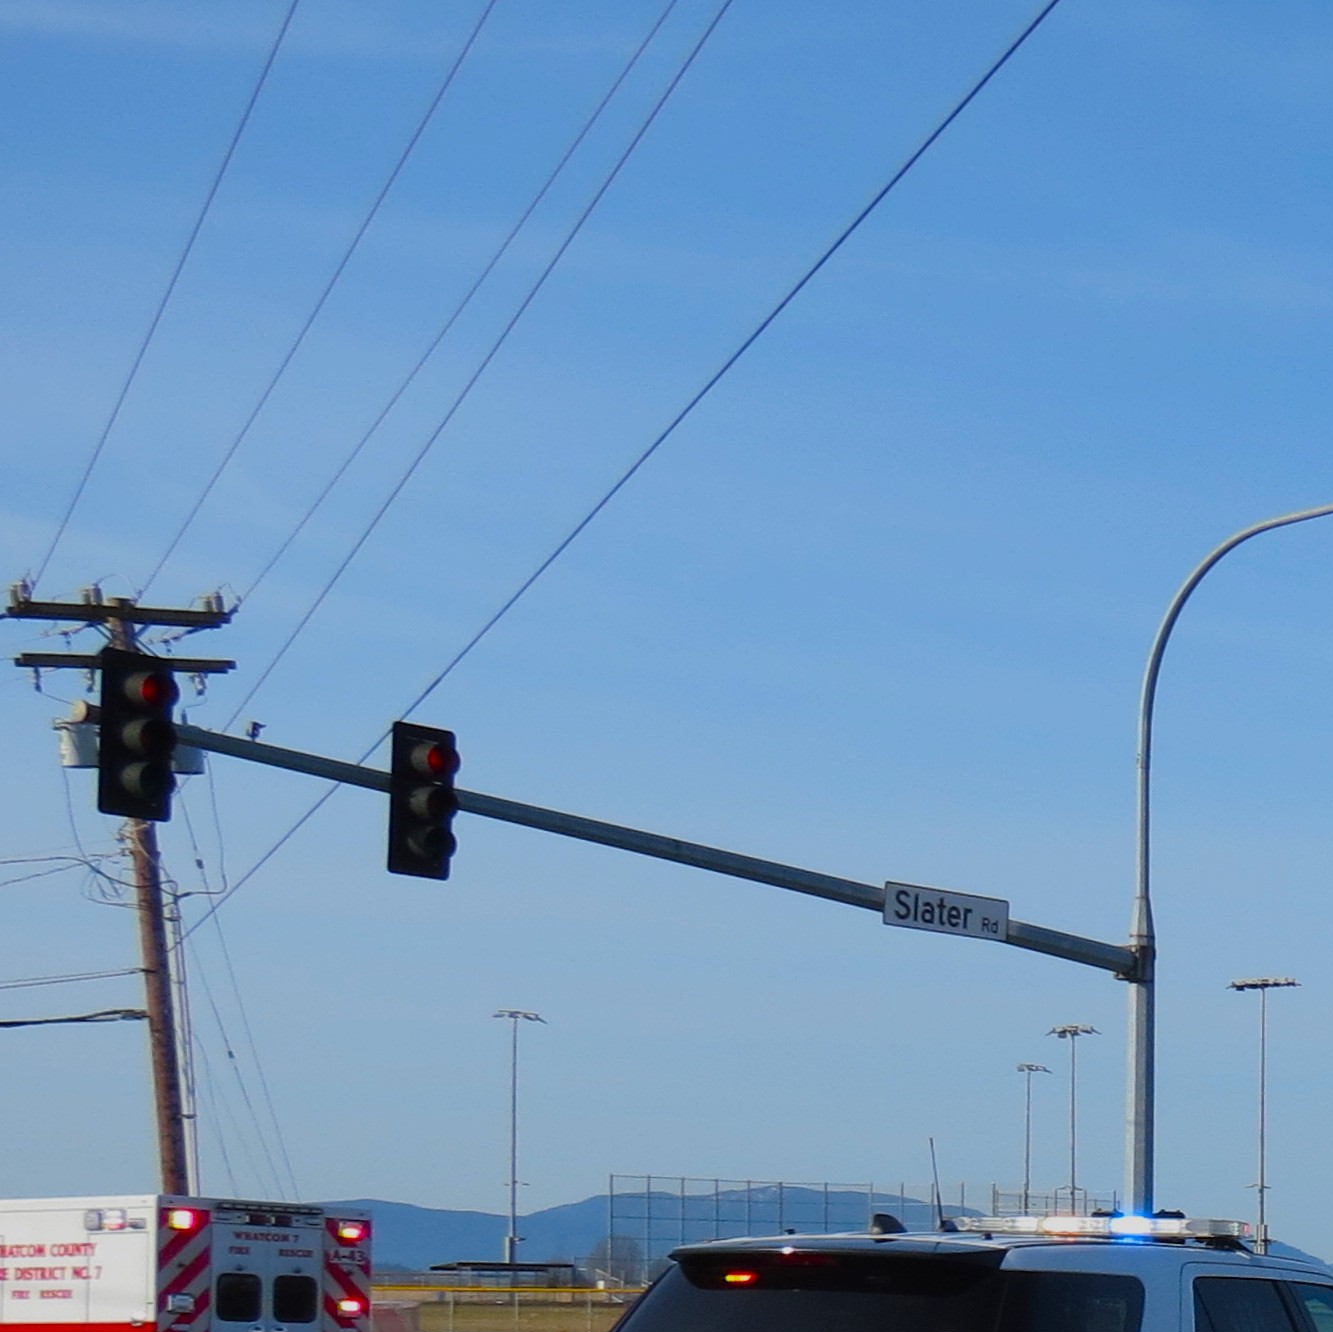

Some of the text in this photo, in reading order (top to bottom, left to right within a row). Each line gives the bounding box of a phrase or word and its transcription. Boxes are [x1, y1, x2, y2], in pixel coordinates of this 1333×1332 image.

[894, 890, 999, 934] Slater Rd
[234, 1232, 300, 1243] WHATCOM 7
[50, 1243, 96, 1257] COUNTY
[330, 1250, 364, 1262] A-43
[15, 1266, 66, 1280] DISTRICT
[95, 1266, 102, 1279] 7
